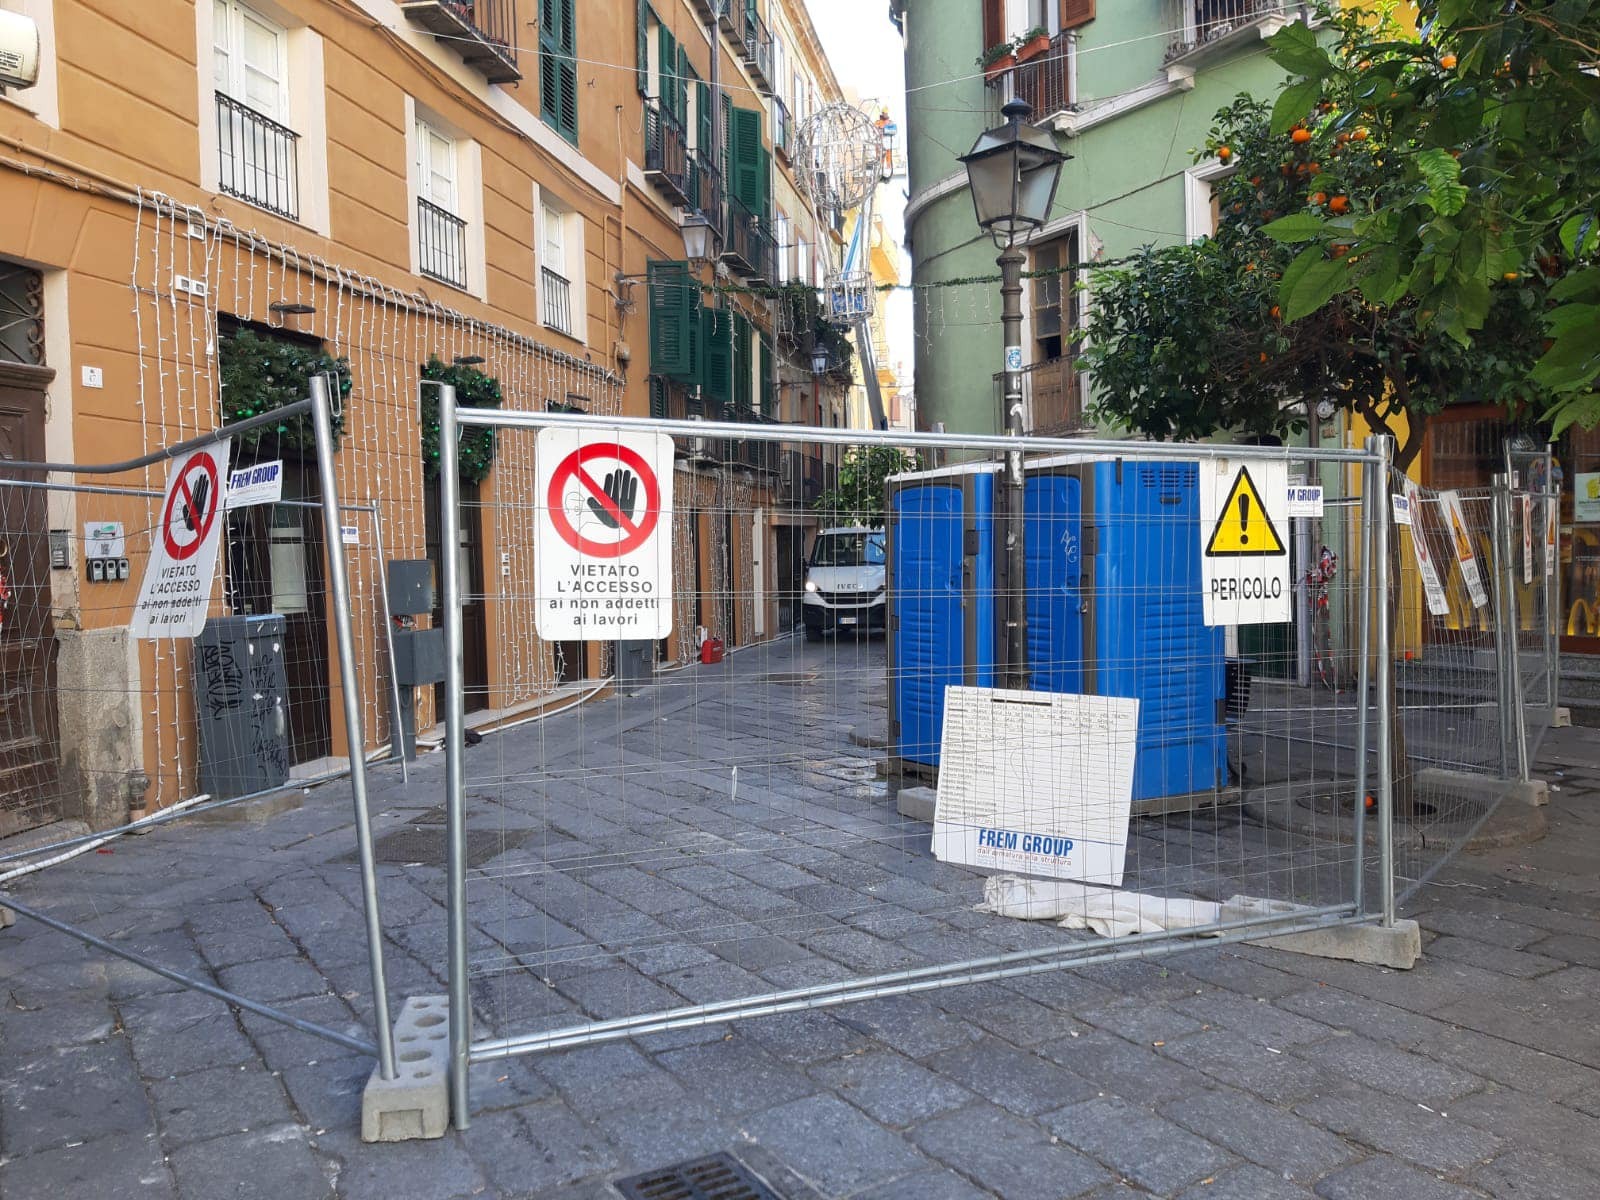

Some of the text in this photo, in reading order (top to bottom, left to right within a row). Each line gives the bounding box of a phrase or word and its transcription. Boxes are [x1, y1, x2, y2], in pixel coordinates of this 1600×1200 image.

[231, 464, 279, 489] FREM GROUP
[1297, 489, 1321, 501] GROUP
[162, 565, 197, 579] VIETATO
[570, 564, 640, 577] VIETATO
[150, 580, 201, 595] L'ACCESSO
[557, 581, 653, 593] L'ACCESSO
[1211, 577, 1281, 600] PERICOLO
[141, 595, 201, 609] ai non addetti
[549, 598, 660, 609] ai non addetti
[149, 612, 186, 624] ai lavori
[573, 613, 638, 625] ai lavori
[979, 828, 1074, 857] FREM GROUP
